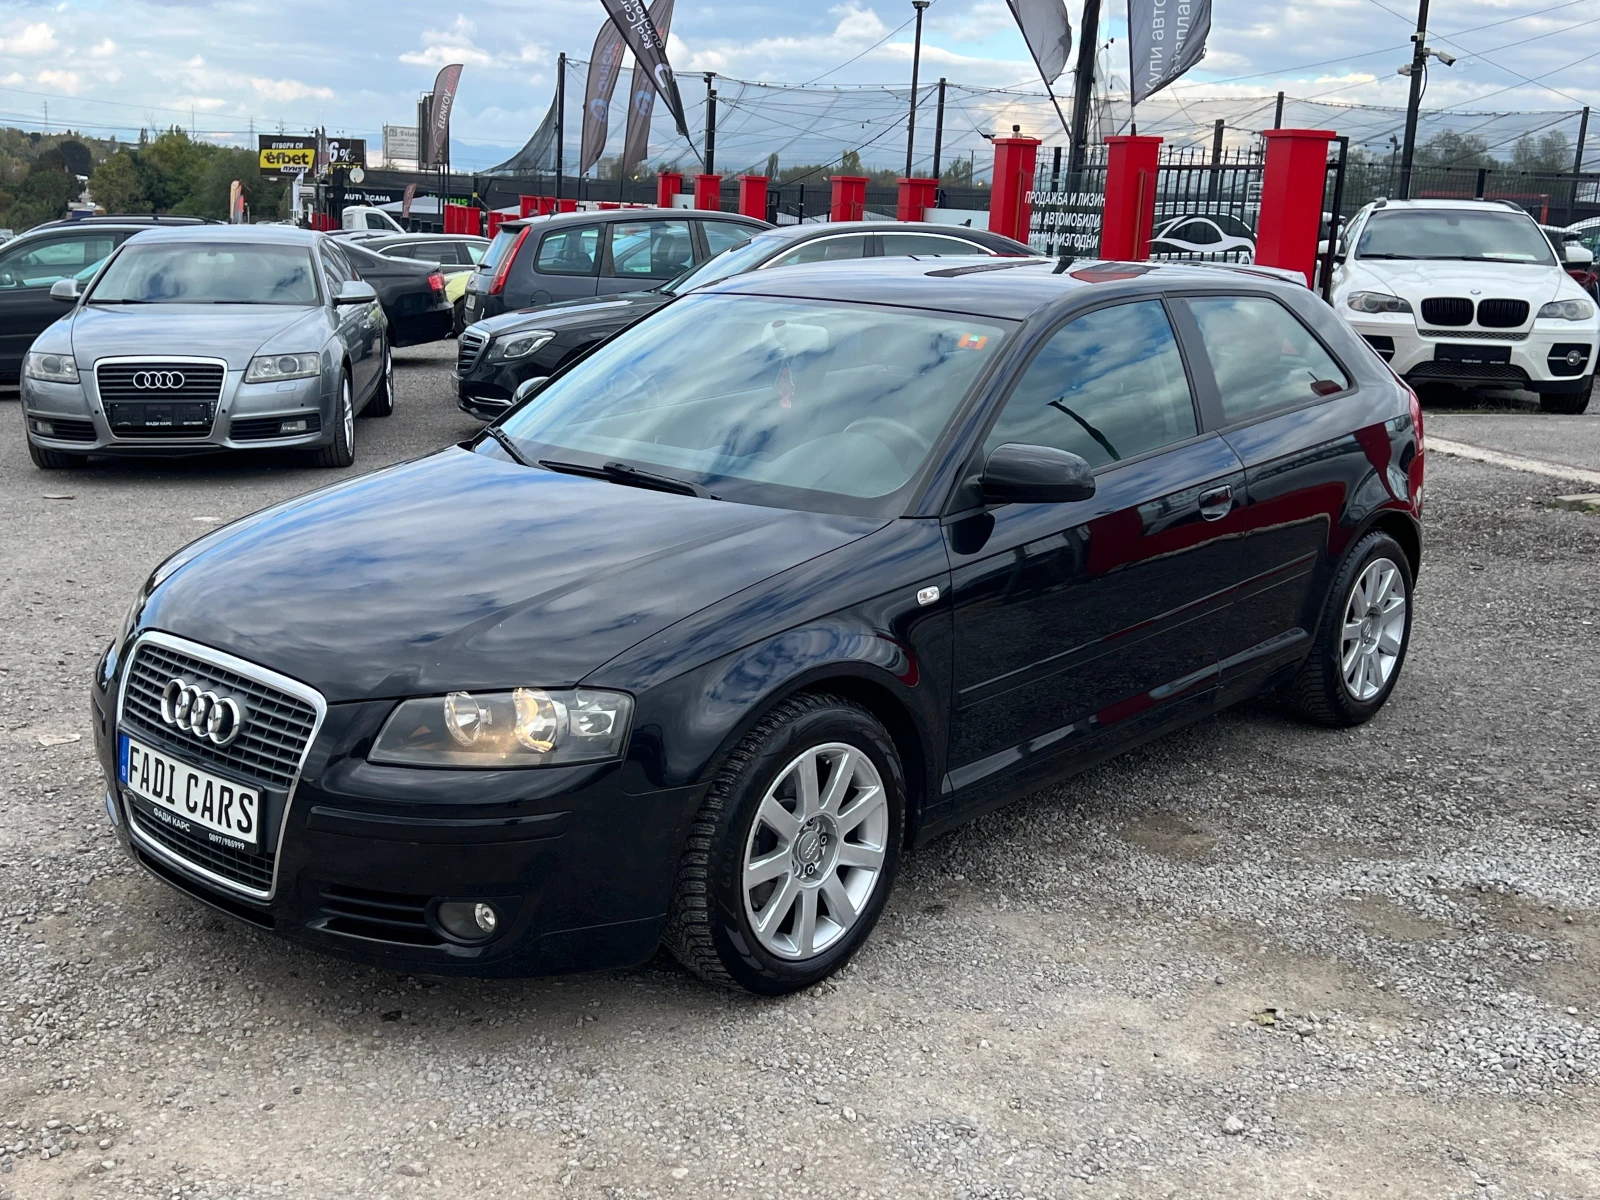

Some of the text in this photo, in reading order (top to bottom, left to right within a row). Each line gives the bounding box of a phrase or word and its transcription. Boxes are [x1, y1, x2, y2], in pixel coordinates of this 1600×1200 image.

[265, 151, 309, 165] efbet
[1025, 191, 1068, 208] ПРОДАЖБА
[1069, 192, 1077, 206] И
[1030, 211, 1101, 228] НА АВТОМОБИЛИ
[129, 745, 254, 834] FADI CARS
[153, 807, 191, 832] ФАДИ КАРС
